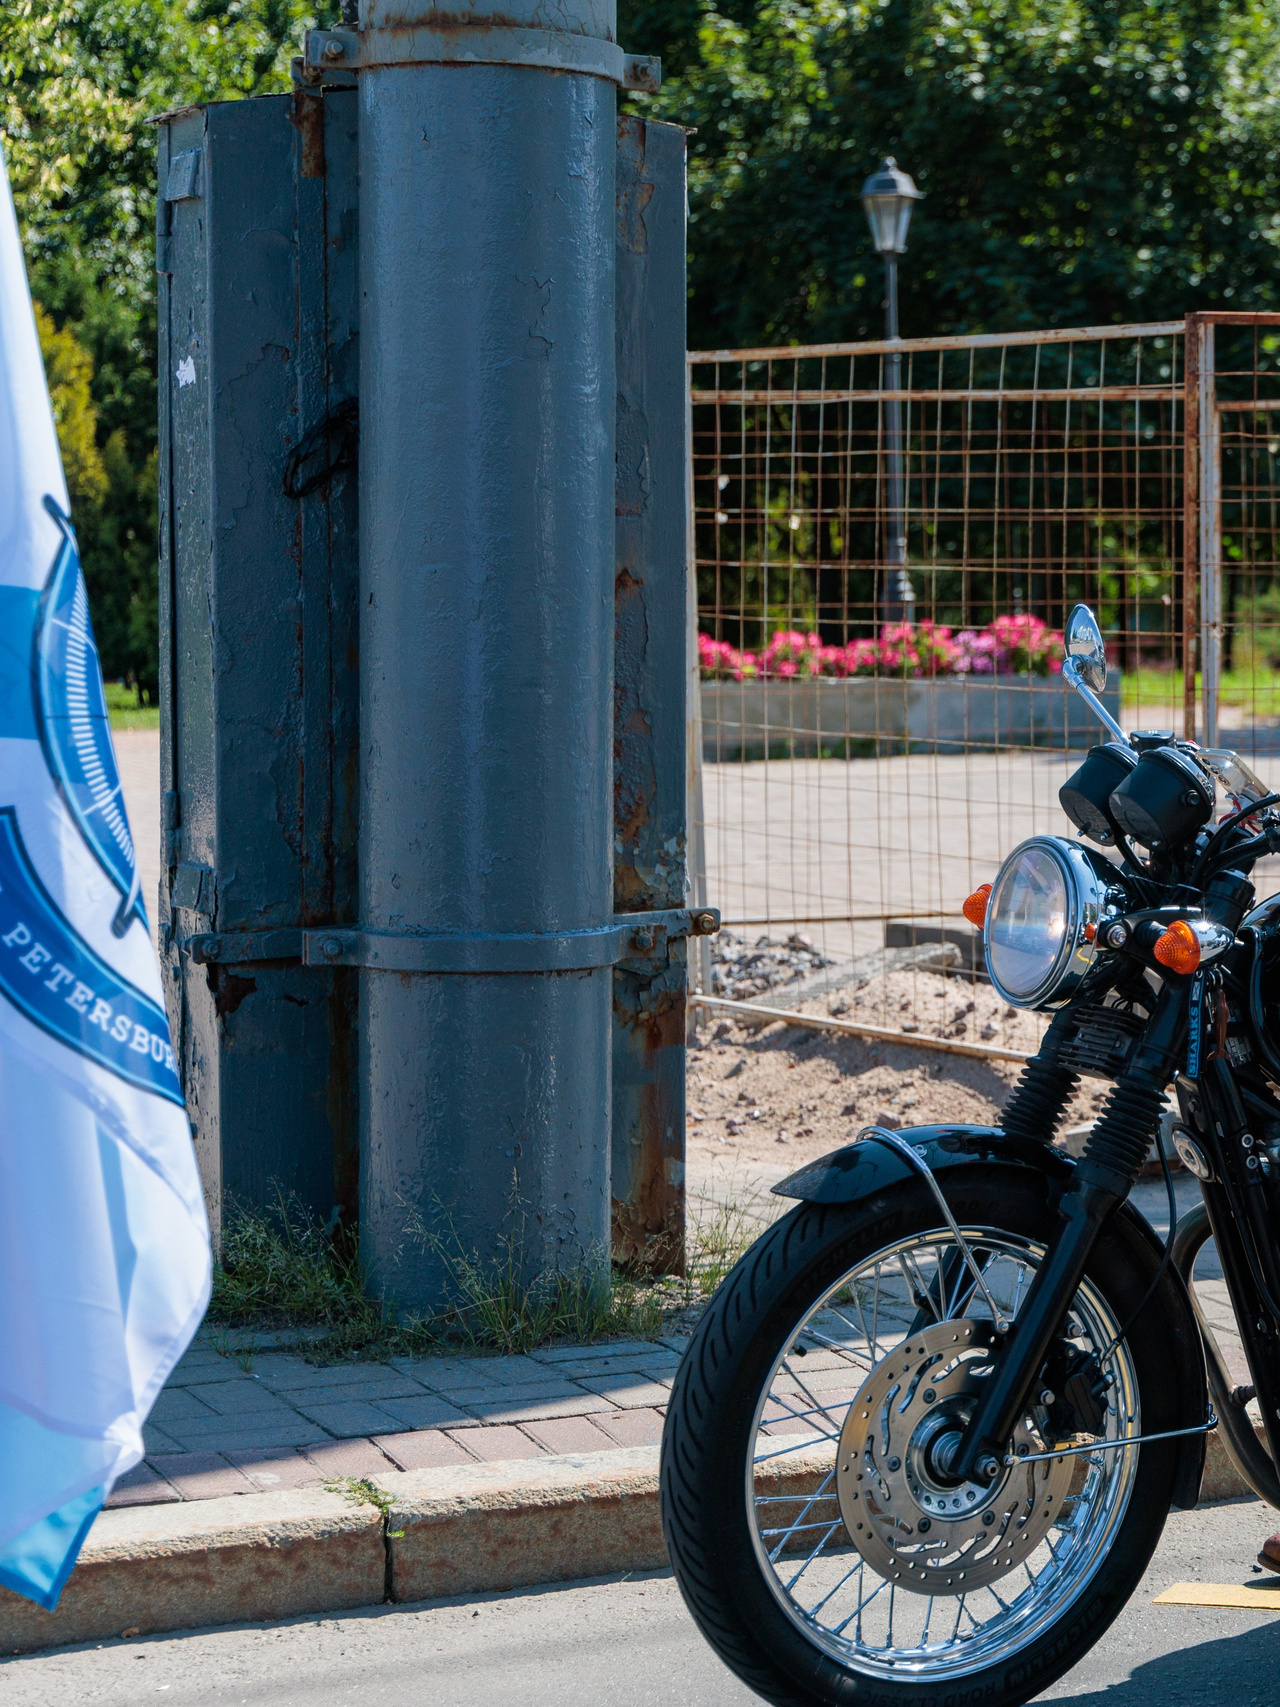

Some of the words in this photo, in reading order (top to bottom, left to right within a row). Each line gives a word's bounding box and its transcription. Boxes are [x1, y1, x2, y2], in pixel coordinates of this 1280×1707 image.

[2, 922, 177, 1073] PETERSBUR
[1188, 1006, 1199, 1074] SHARKS
[1008, 1597, 1106, 1689] MICHELIN
